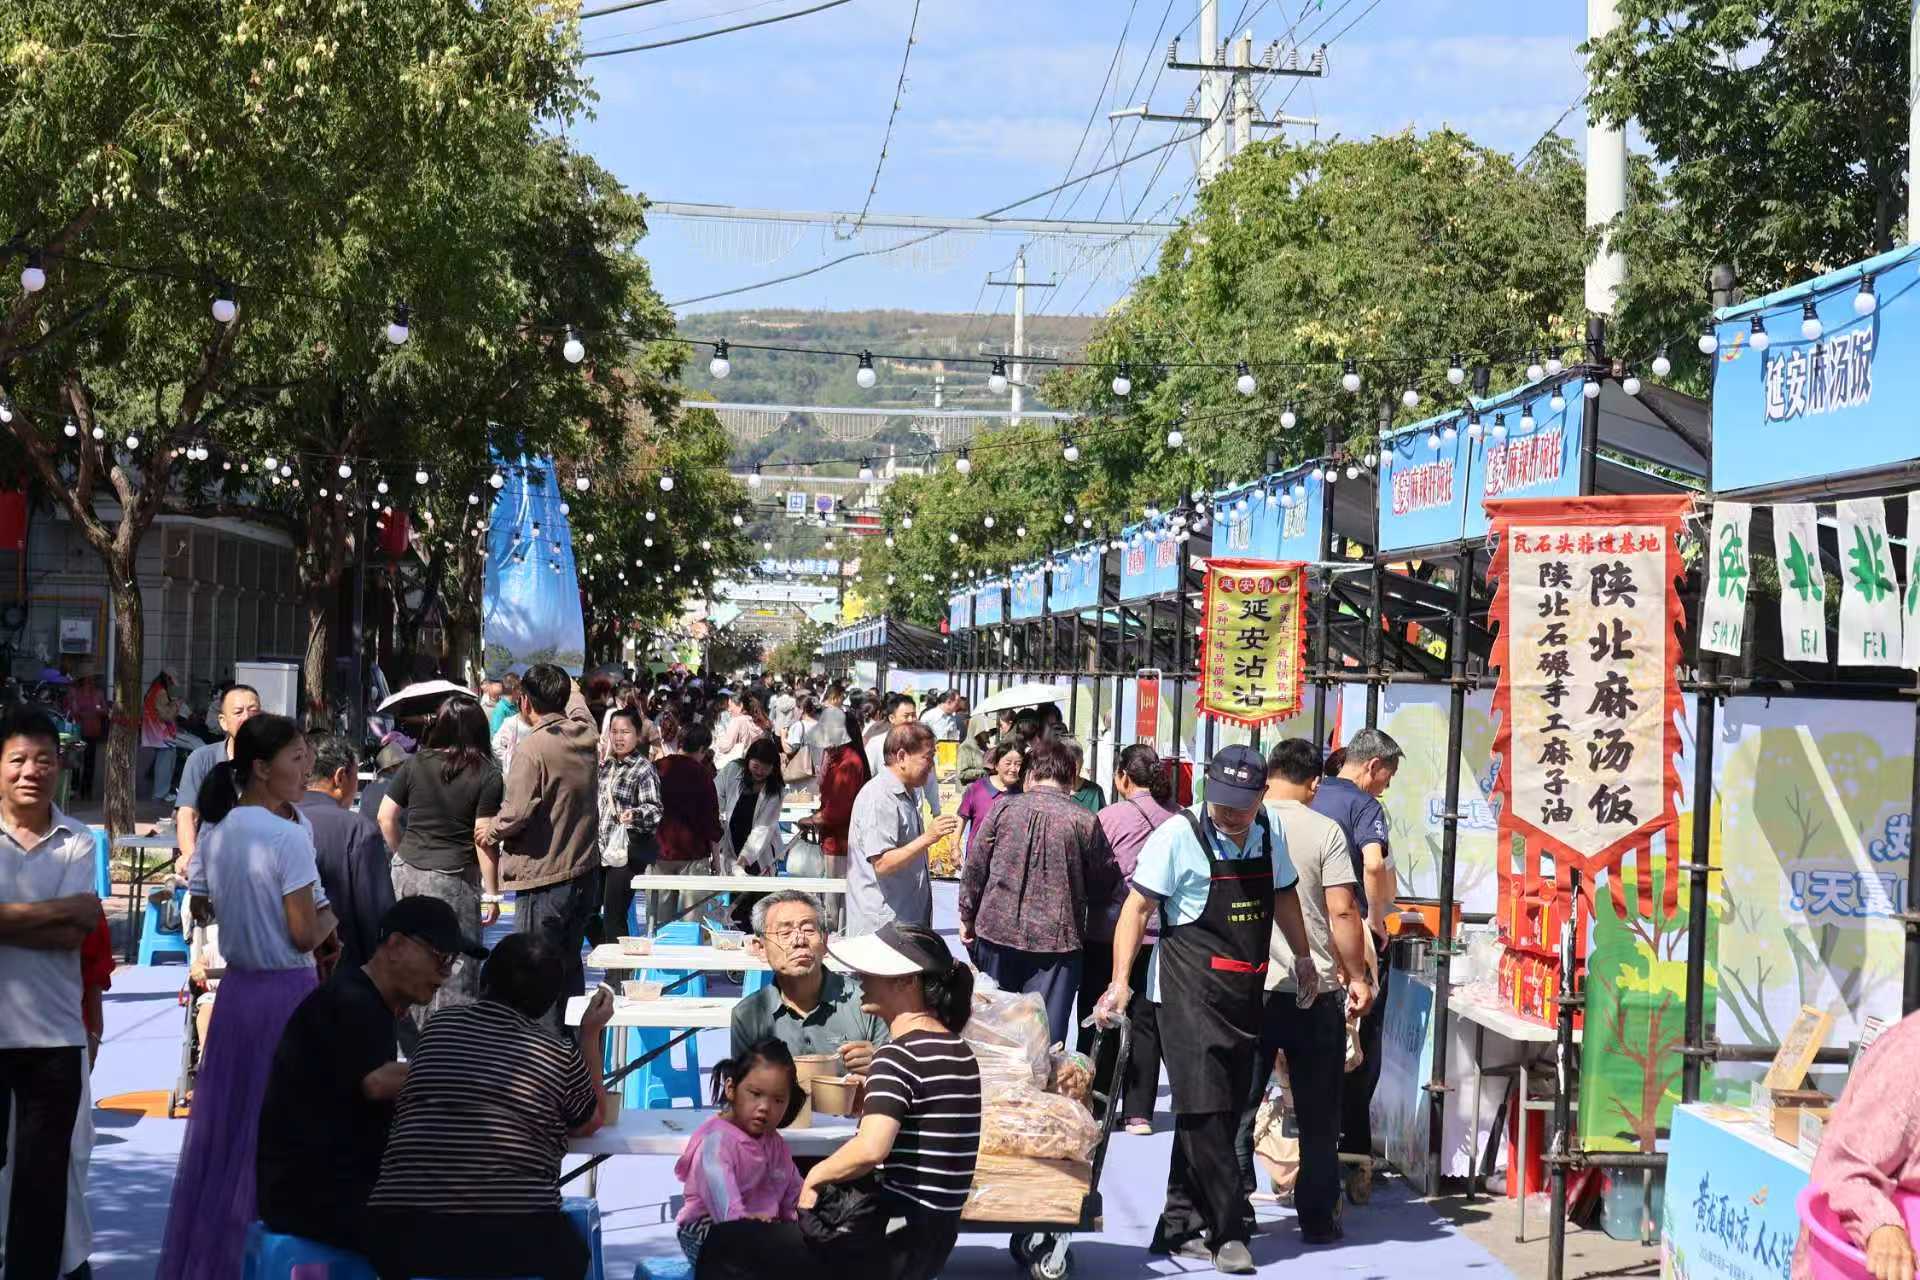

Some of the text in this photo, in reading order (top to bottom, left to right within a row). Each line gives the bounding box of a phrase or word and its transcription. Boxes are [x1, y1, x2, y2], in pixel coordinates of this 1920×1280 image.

[1764, 327, 1873, 425] 延安麻汤饭
[1219, 576, 1293, 594] 延安特色
[1513, 532, 1661, 554] 瓦石头非遗基地
[1232, 598, 1271, 707] 延安沾沾
[1536, 561, 1574, 824] 陕北石碾手工麻子油
[1586, 560, 1638, 825] 陕北麻汤饭
